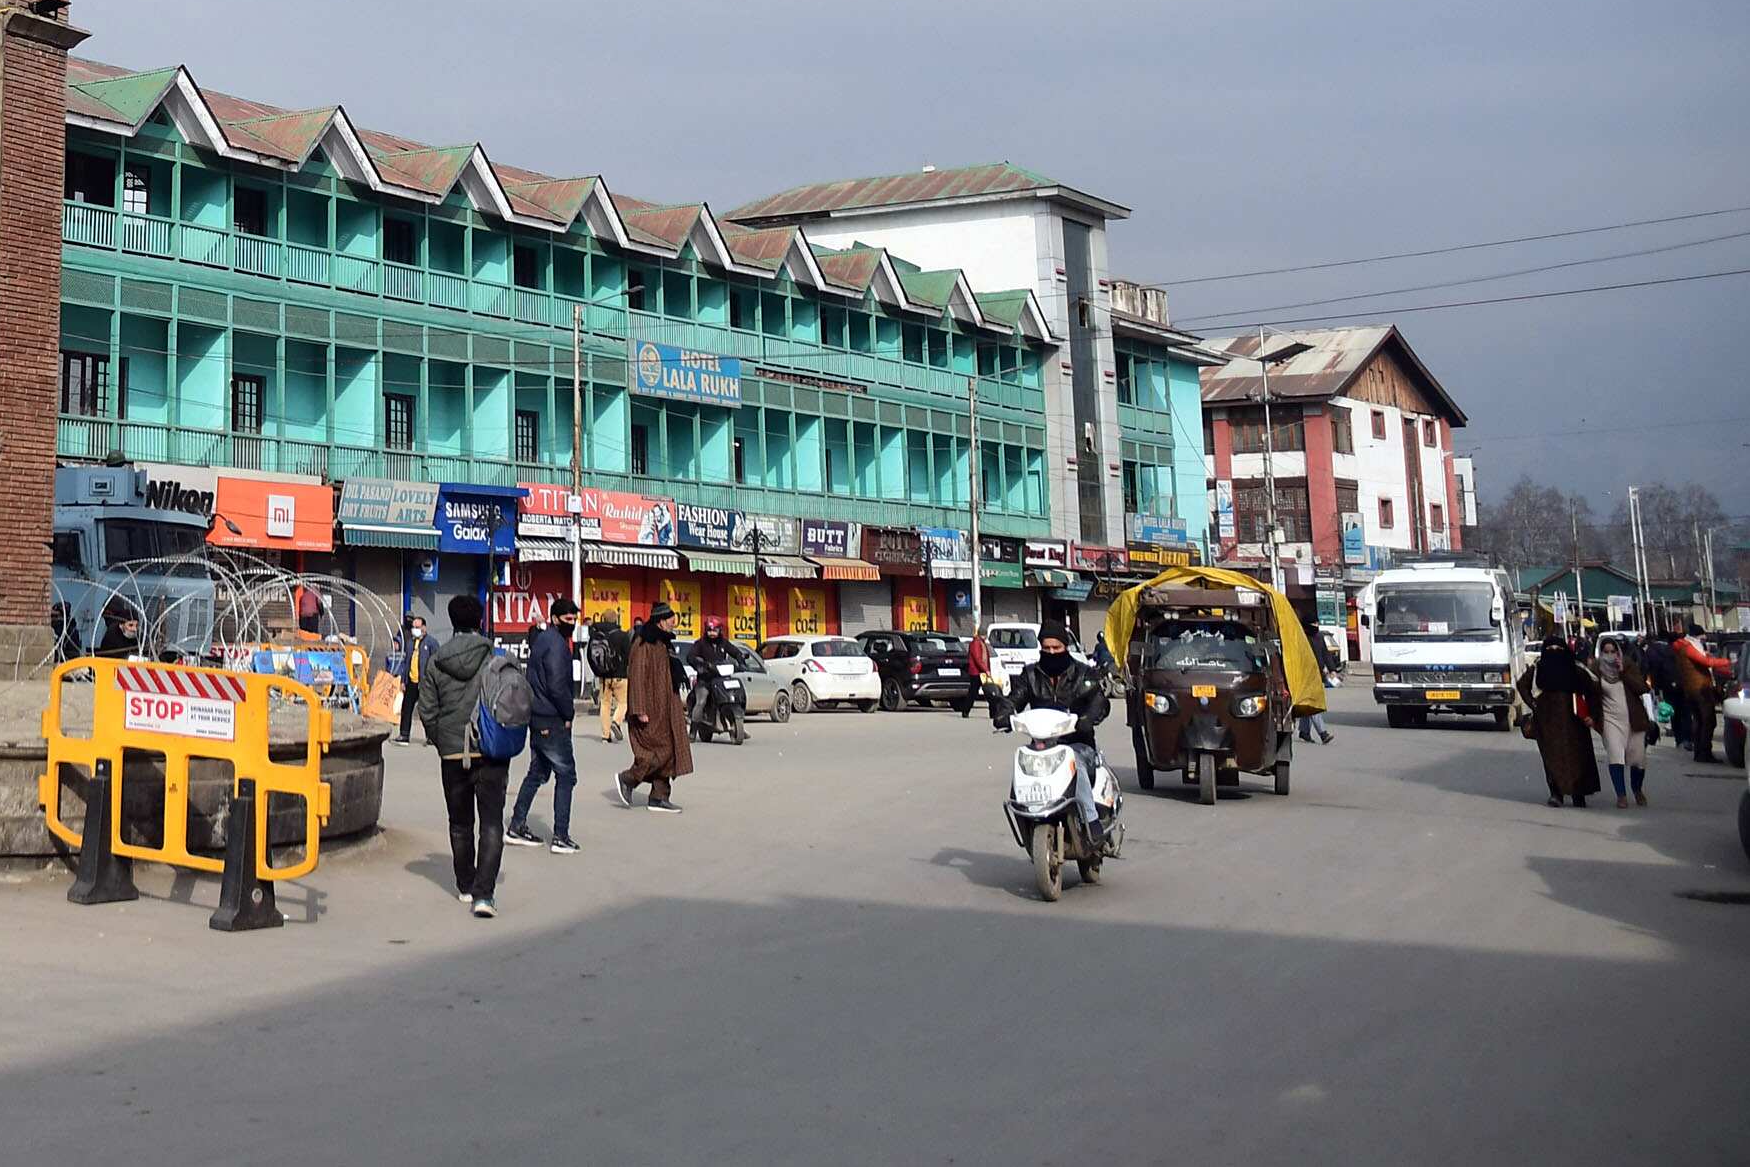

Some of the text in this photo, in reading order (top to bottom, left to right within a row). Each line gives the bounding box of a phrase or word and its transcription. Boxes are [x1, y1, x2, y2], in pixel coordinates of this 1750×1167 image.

[681, 350, 721, 372] HOTEL
[663, 367, 698, 391] LALA
[700, 373, 739, 399] RUKH
[146, 480, 214, 517] Nikon
[346, 484, 391, 500] DIL PASAND
[393, 488, 436, 506] LOVELY
[539, 489, 598, 513] TITN
[342, 504, 389, 520] DRY FRUITS
[395, 508, 427, 522] ARTS
[522, 514, 553, 524] ROBERTA
[602, 502, 643, 520] Rashid
[678, 505, 729, 525] FASHION
[688, 522, 707, 537] Wear
[708, 524, 728, 540] House
[807, 528, 845, 544] BUTT
[795, 614, 818, 634] cozi
[130, 697, 184, 720] STOP
